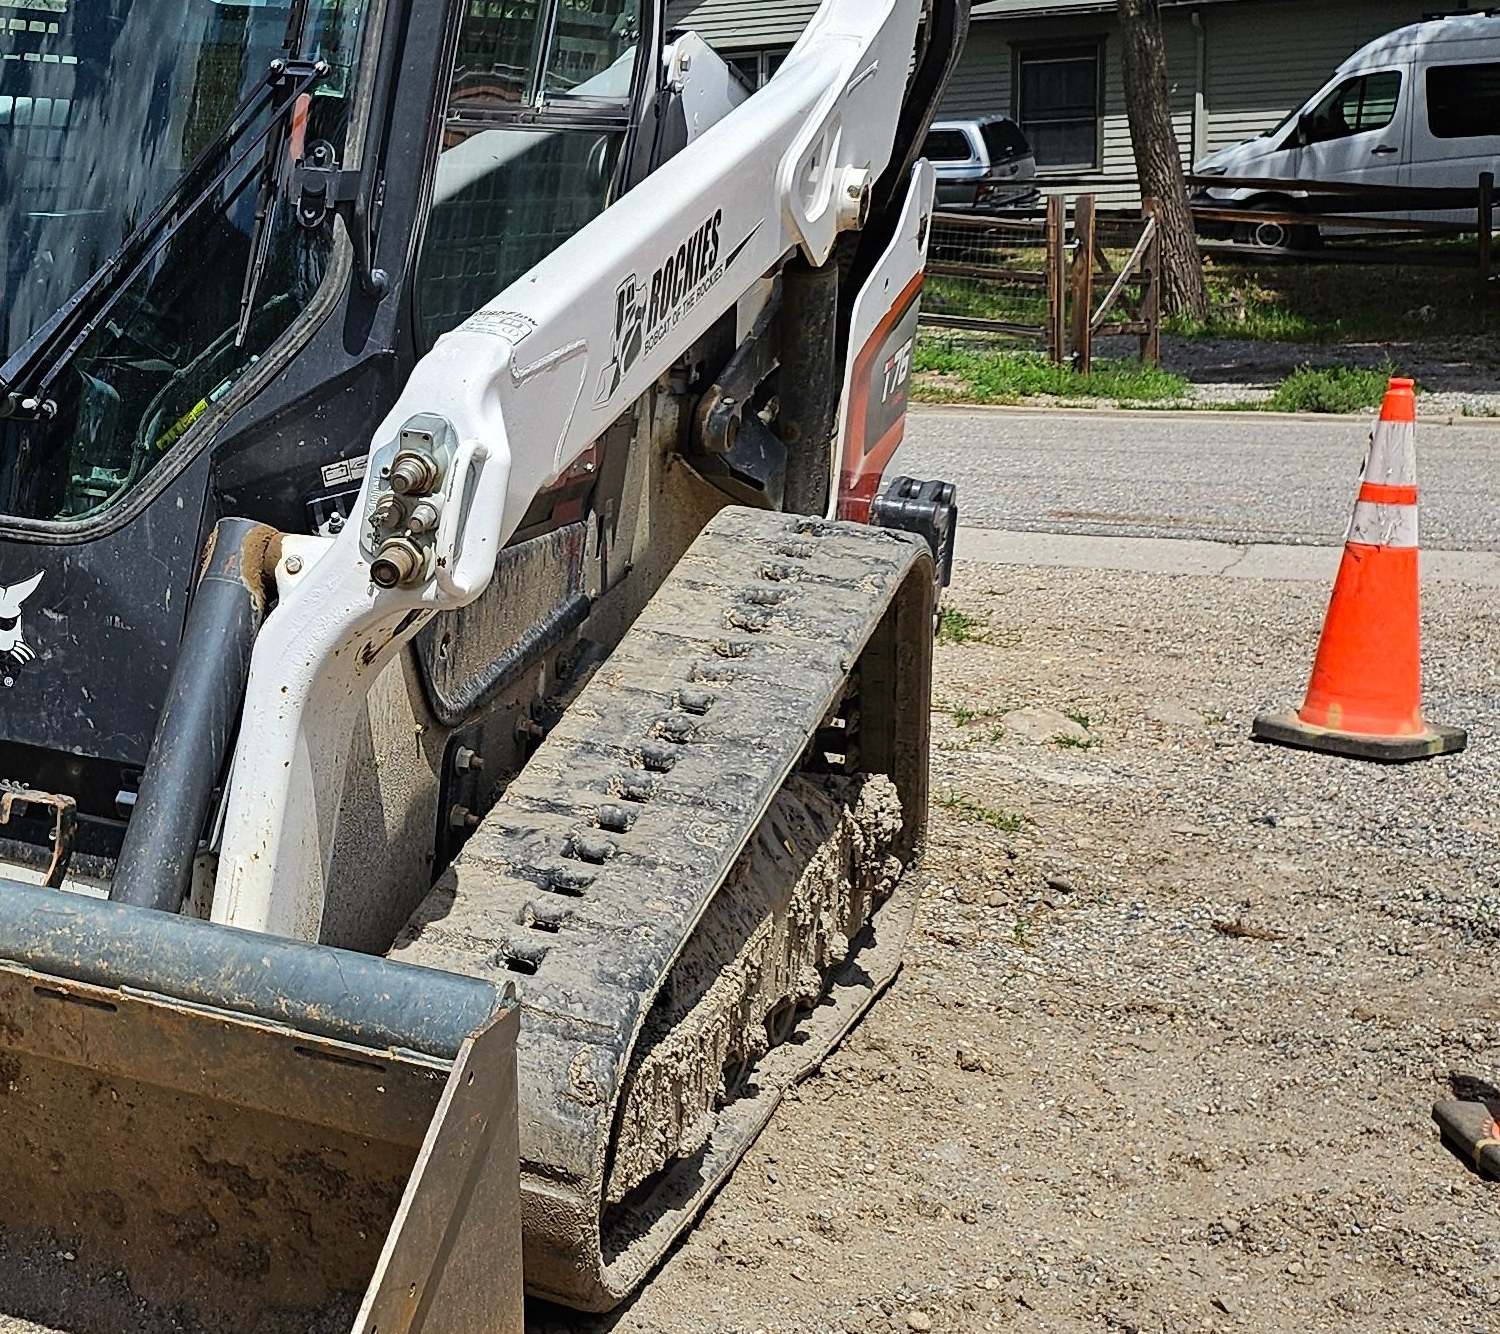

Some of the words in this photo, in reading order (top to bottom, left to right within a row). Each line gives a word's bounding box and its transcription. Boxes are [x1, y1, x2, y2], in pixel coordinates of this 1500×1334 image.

[644, 317, 671, 356] BOBCAT
[696, 264, 723, 302] ROCKIES
[646, 208, 722, 336] ROCKIES
